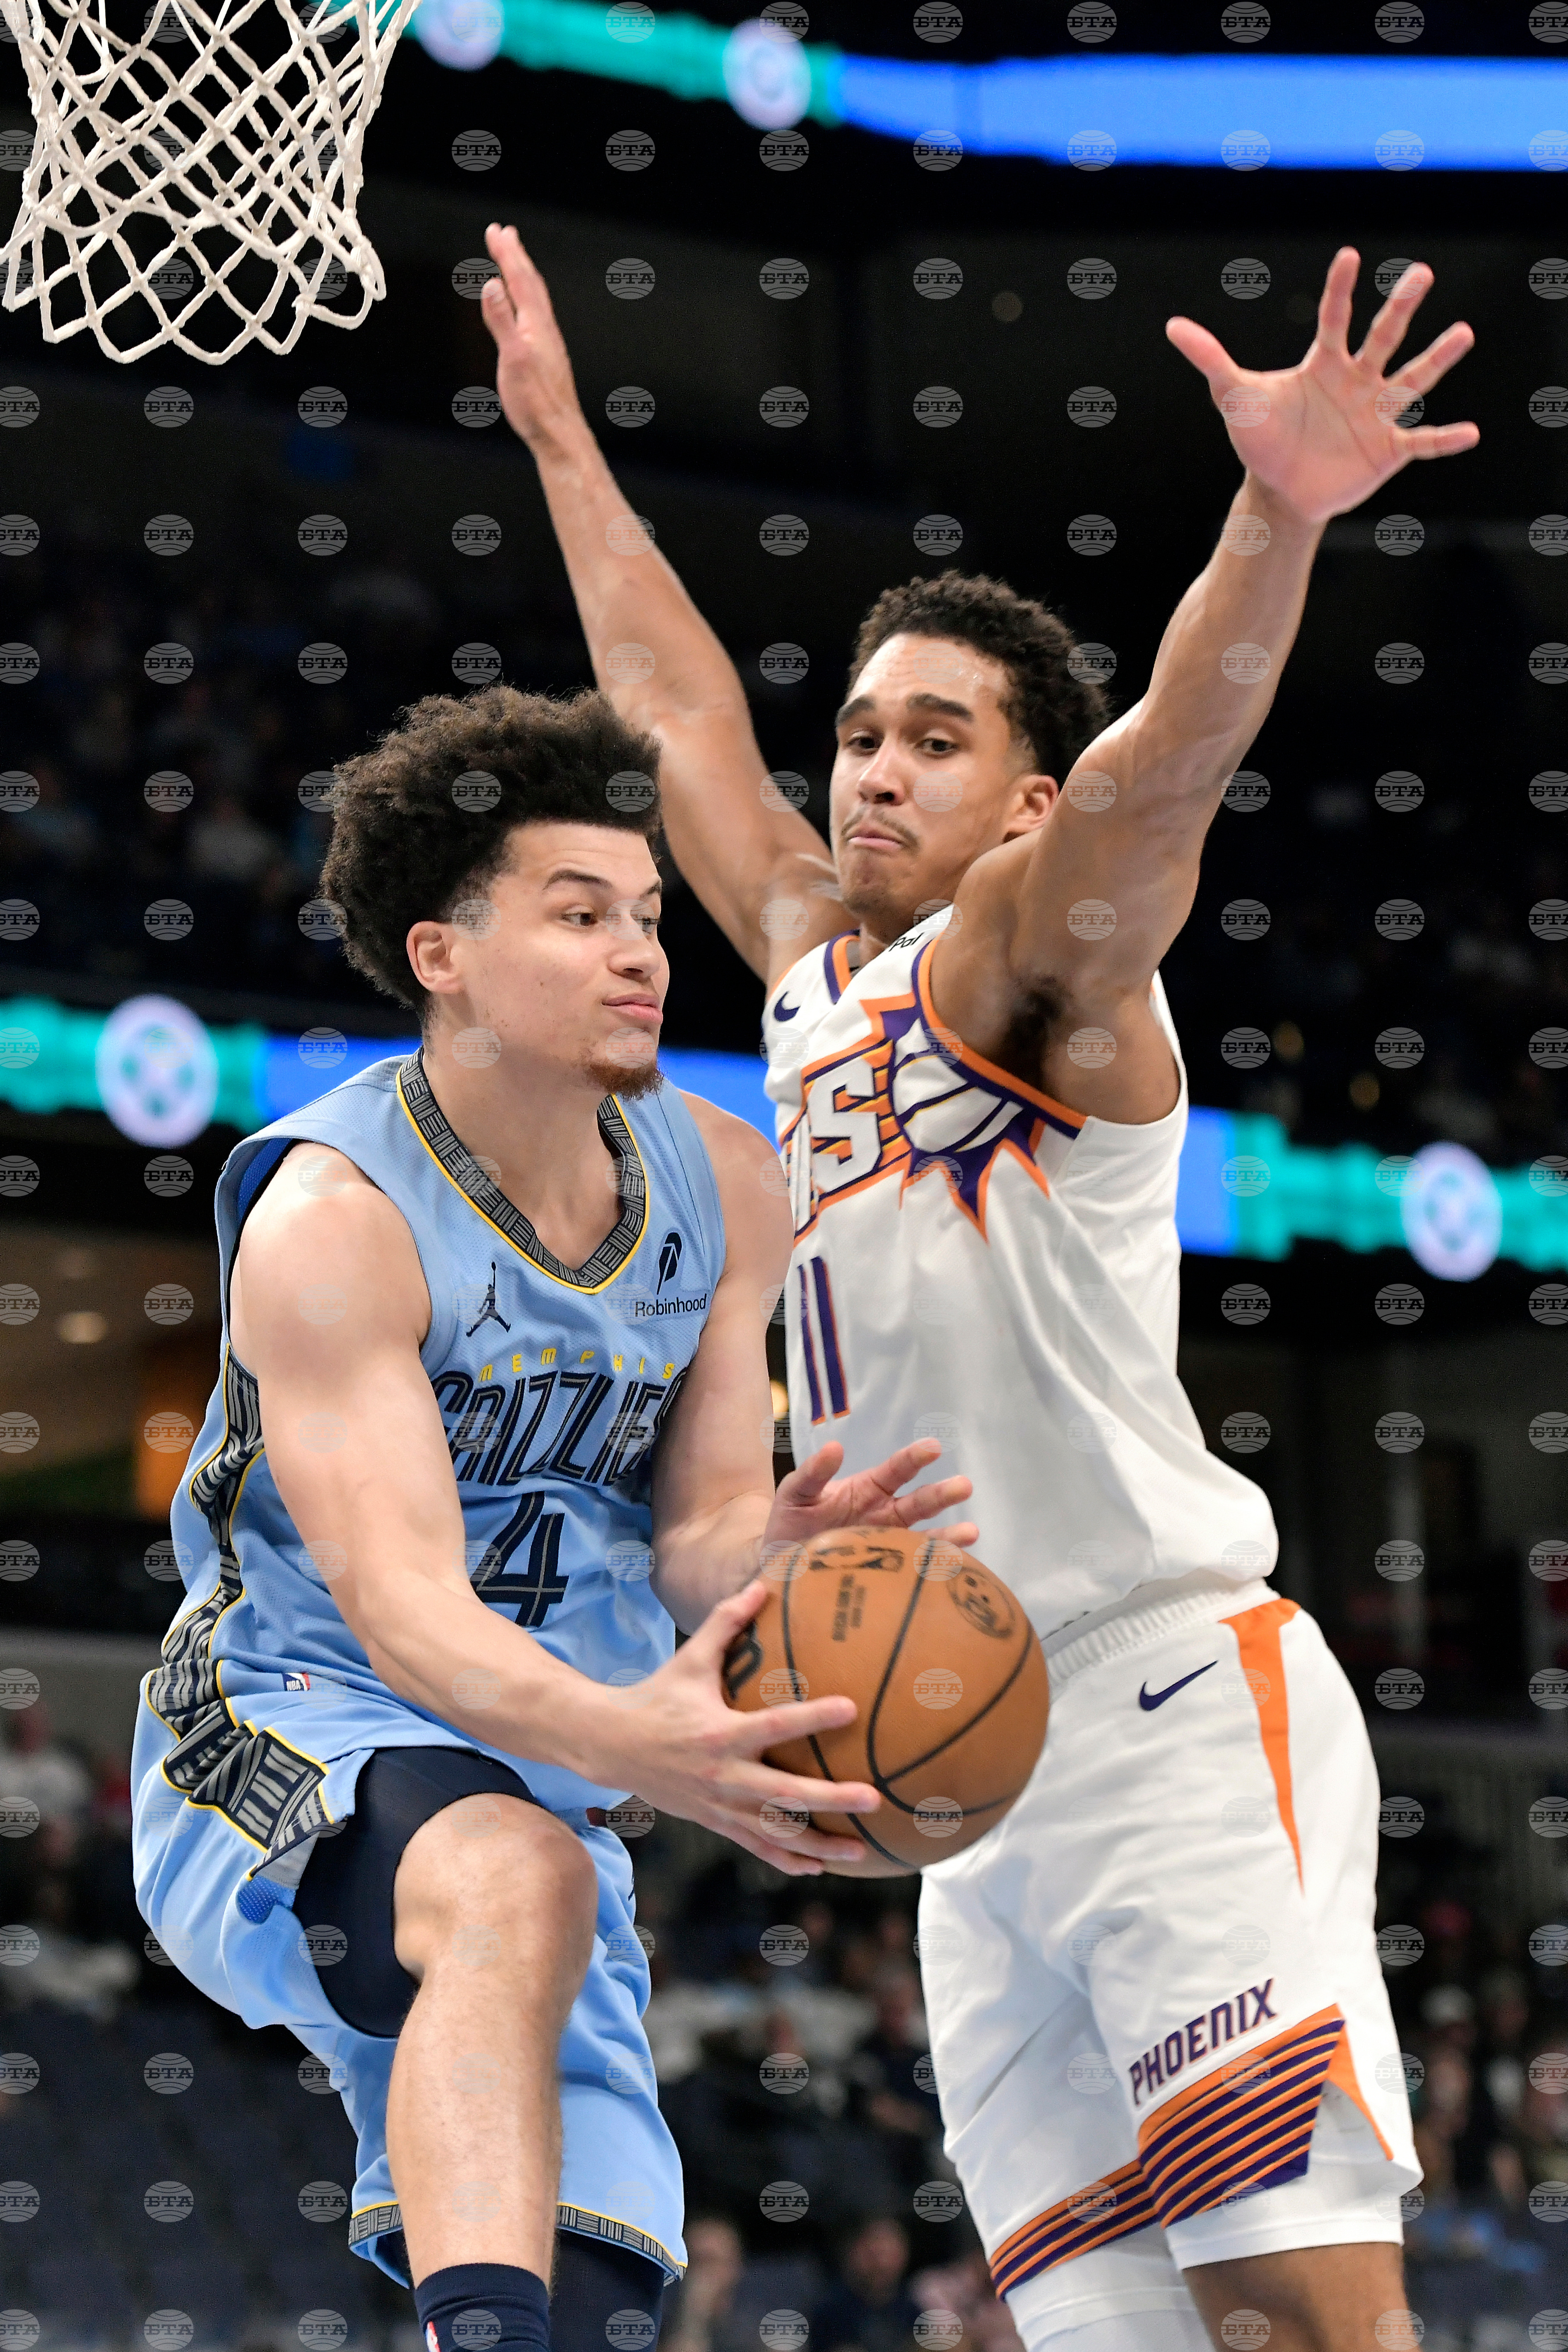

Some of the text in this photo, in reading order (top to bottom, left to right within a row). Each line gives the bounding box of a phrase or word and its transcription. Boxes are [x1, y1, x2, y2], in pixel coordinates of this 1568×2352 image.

[635, 1293, 707, 1317] Robinhood
[797, 1255, 850, 1426] 11
[478, 1348, 675, 1382] MEMPHIS
[470, 1491, 569, 1627] 4
[286, 1679, 302, 1691] NBA
[1128, 1977, 1277, 2106] PHOENIX
